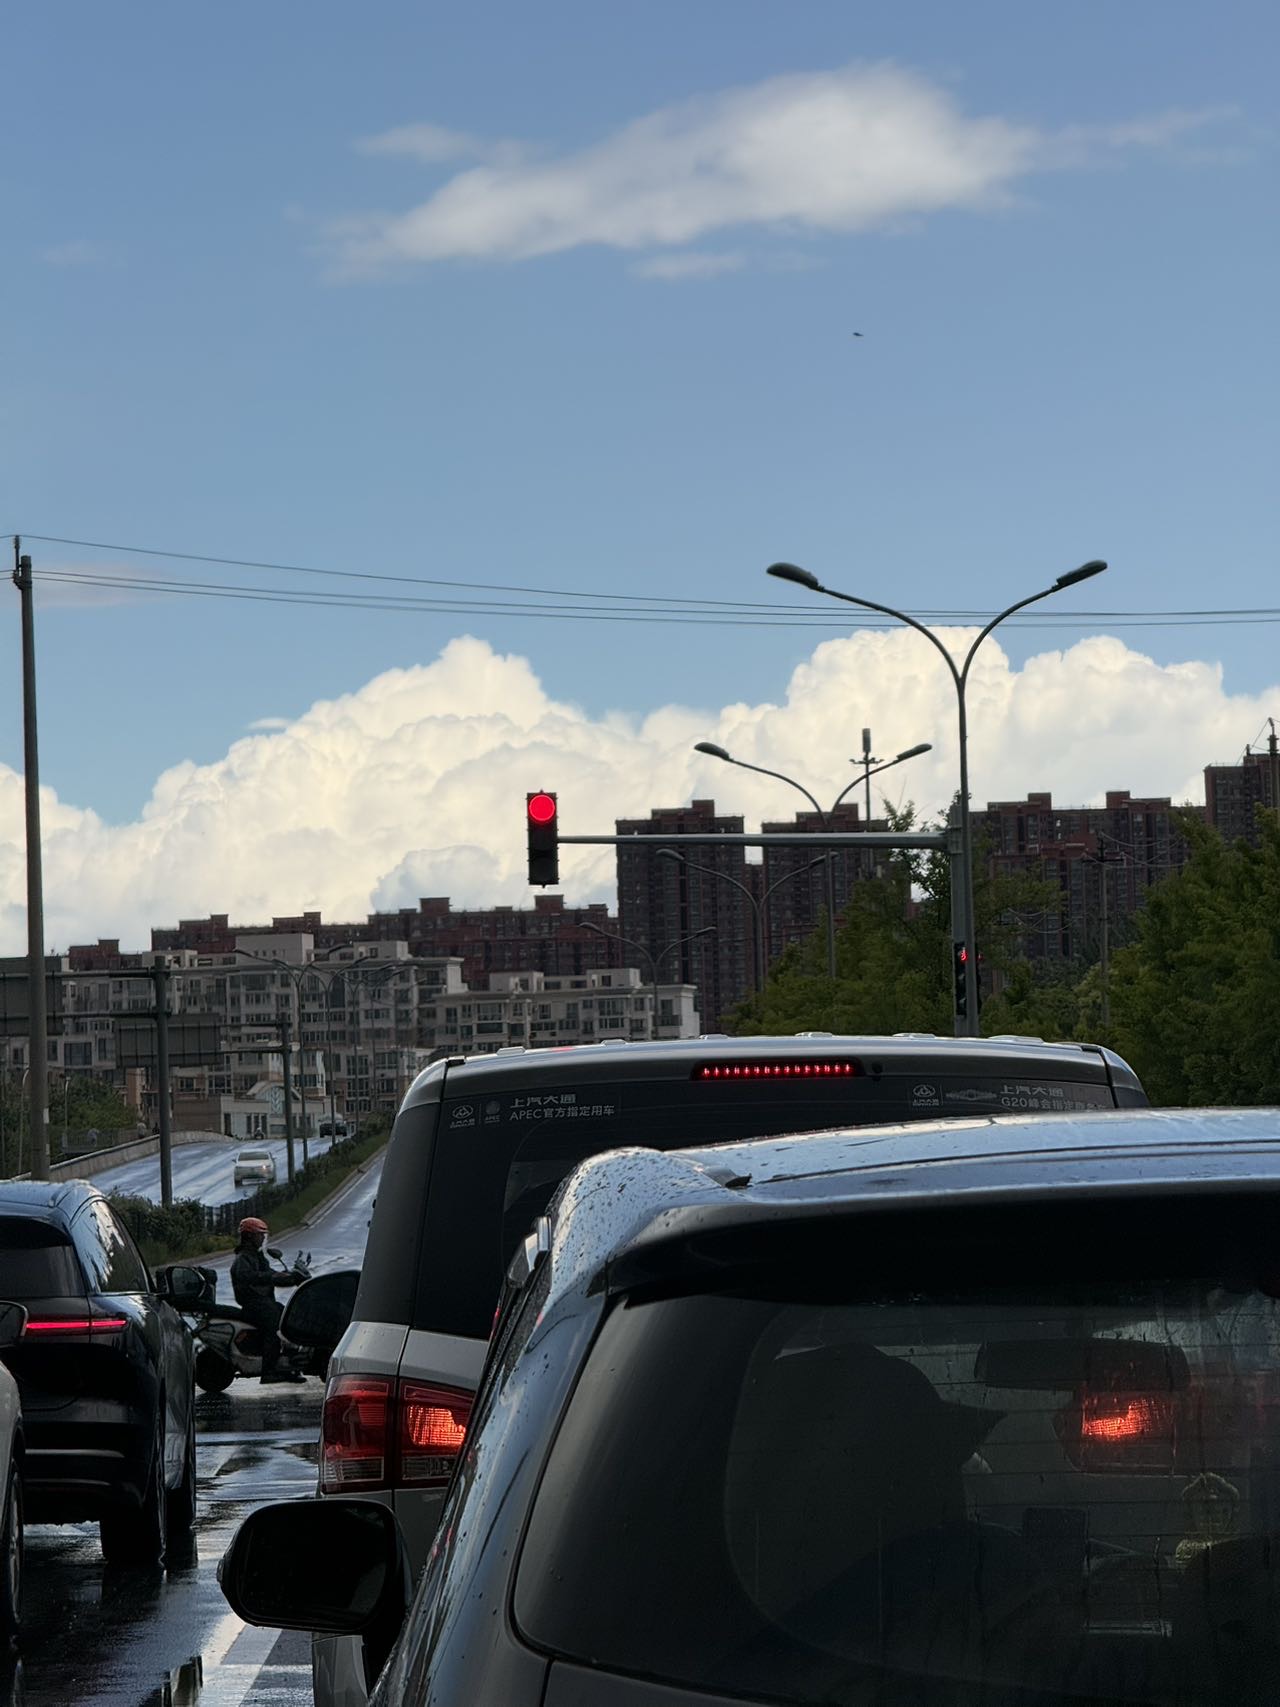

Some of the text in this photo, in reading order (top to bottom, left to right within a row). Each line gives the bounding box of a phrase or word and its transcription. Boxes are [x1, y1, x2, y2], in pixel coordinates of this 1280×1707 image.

[1000, 1085, 1064, 1097] 上汽大通
[510, 1093, 576, 1108] 上汽大通
[509, 1105, 615, 1121] APEC官方指定用车
